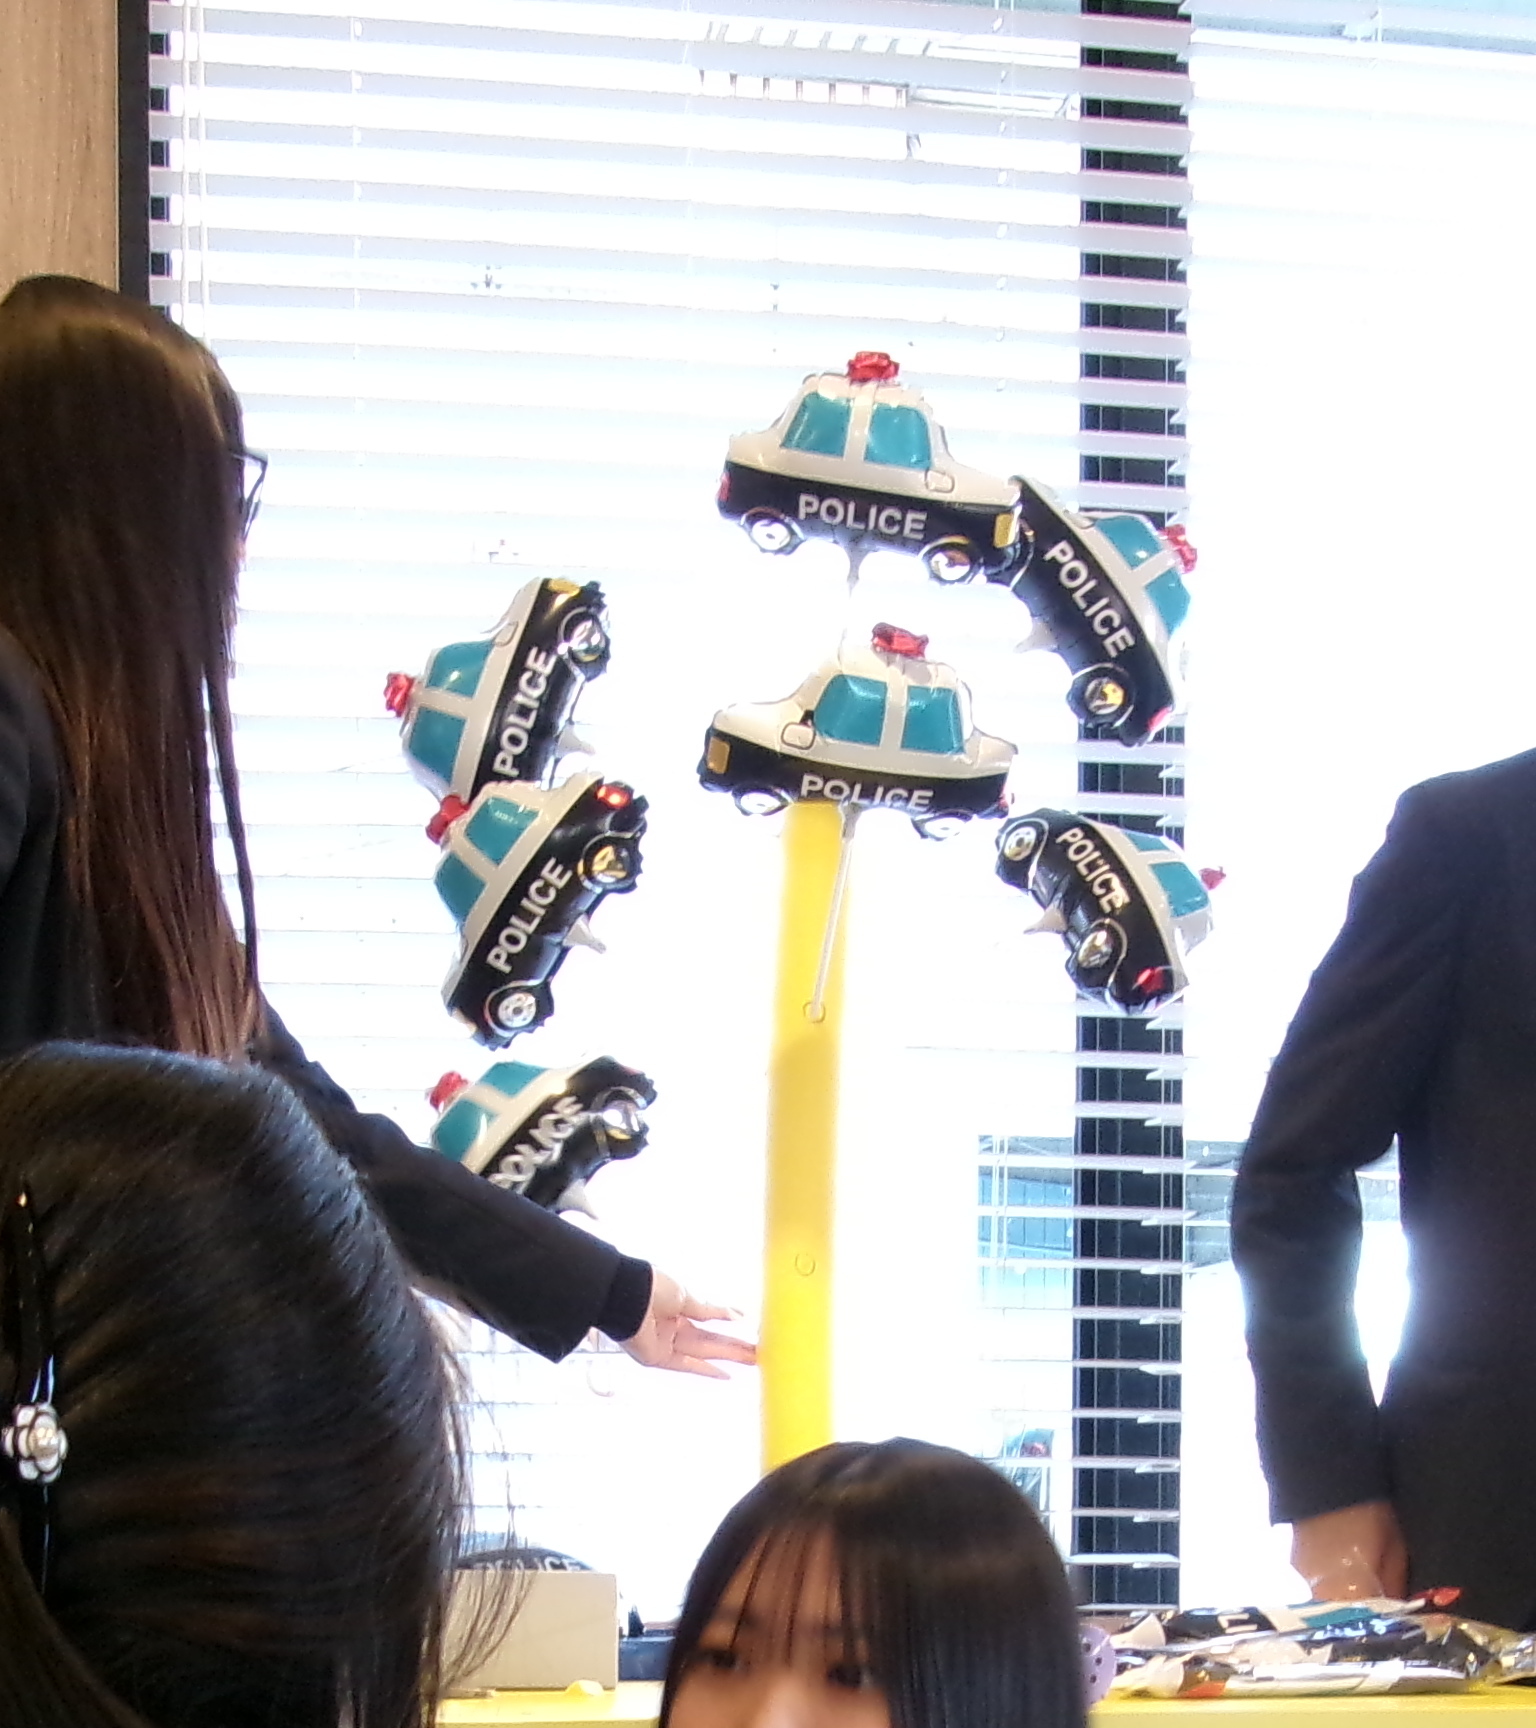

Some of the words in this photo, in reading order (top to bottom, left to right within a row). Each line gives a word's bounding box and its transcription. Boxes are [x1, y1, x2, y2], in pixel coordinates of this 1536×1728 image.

[797, 494, 928, 541] POLICE
[1043, 540, 1135, 658] POLICE
[493, 647, 560, 779] POLICE
[800, 774, 934, 810] POLICE
[486, 859, 573, 974] POLICE
[1054, 827, 1129, 914] POLICE
